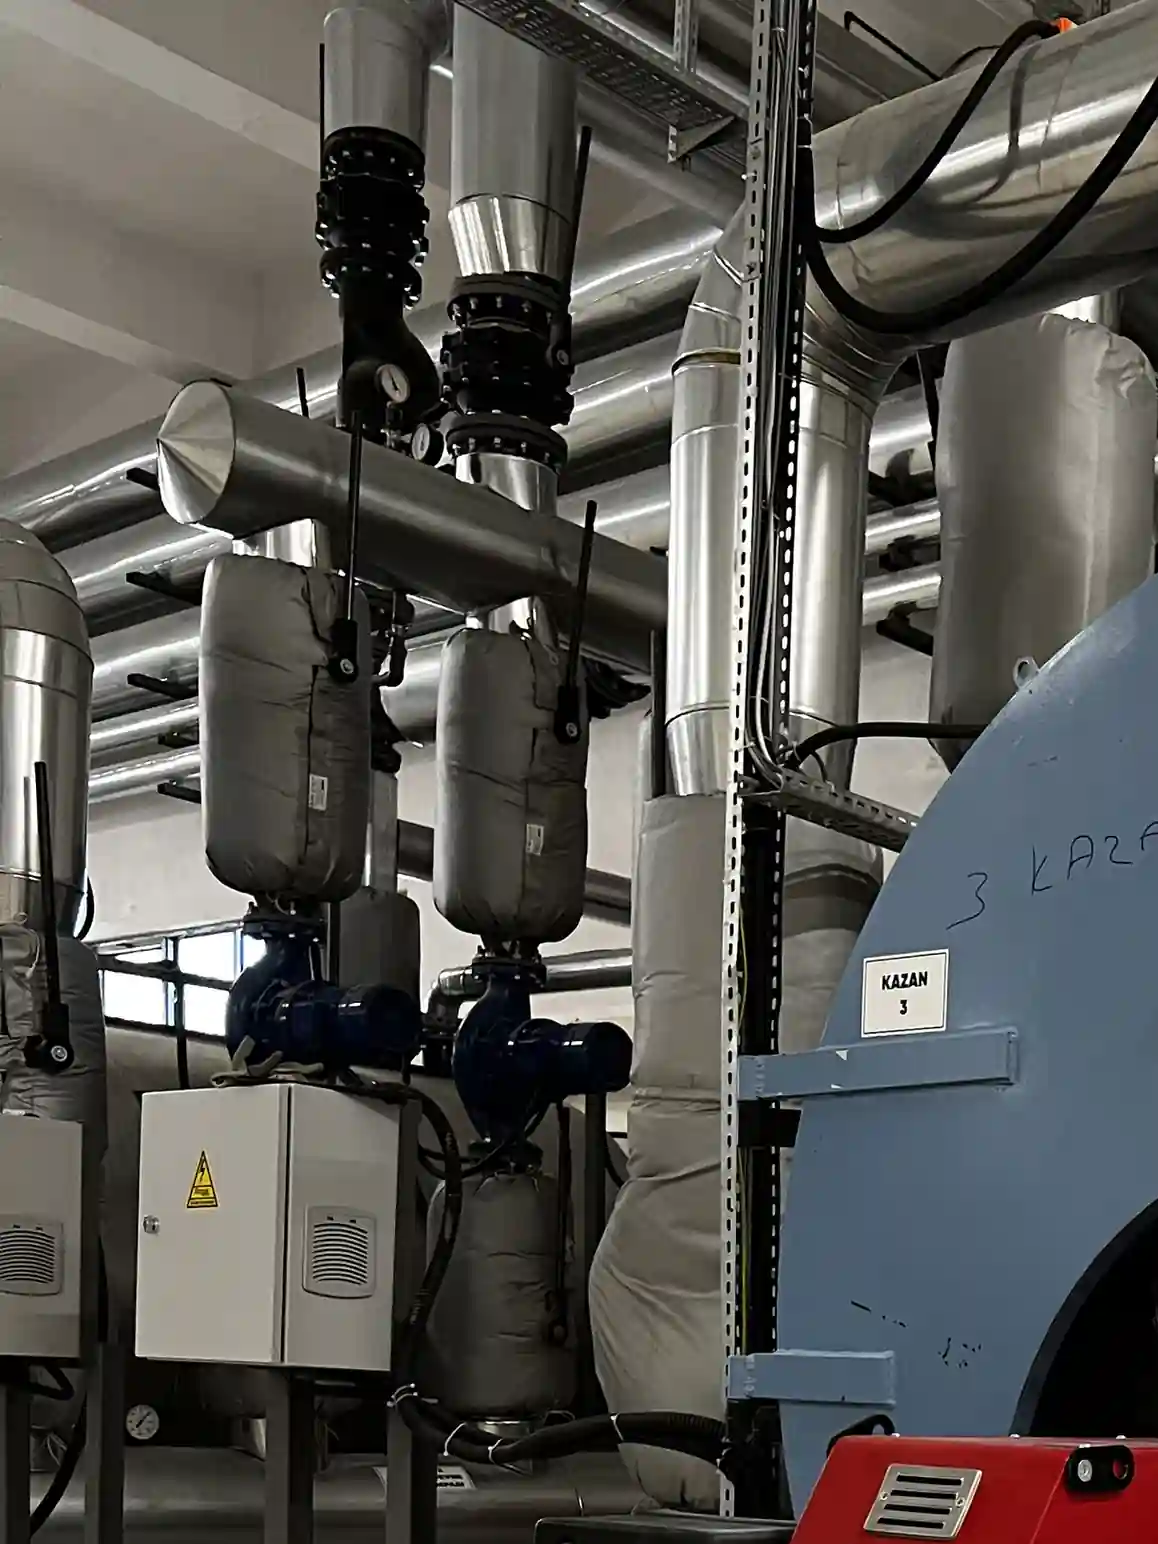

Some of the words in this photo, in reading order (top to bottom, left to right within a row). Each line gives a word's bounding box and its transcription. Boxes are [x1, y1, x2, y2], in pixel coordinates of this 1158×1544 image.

[946, 872, 988, 930] 3
[881, 971, 928, 991] KAZAN
[899, 999, 908, 1016] 3
